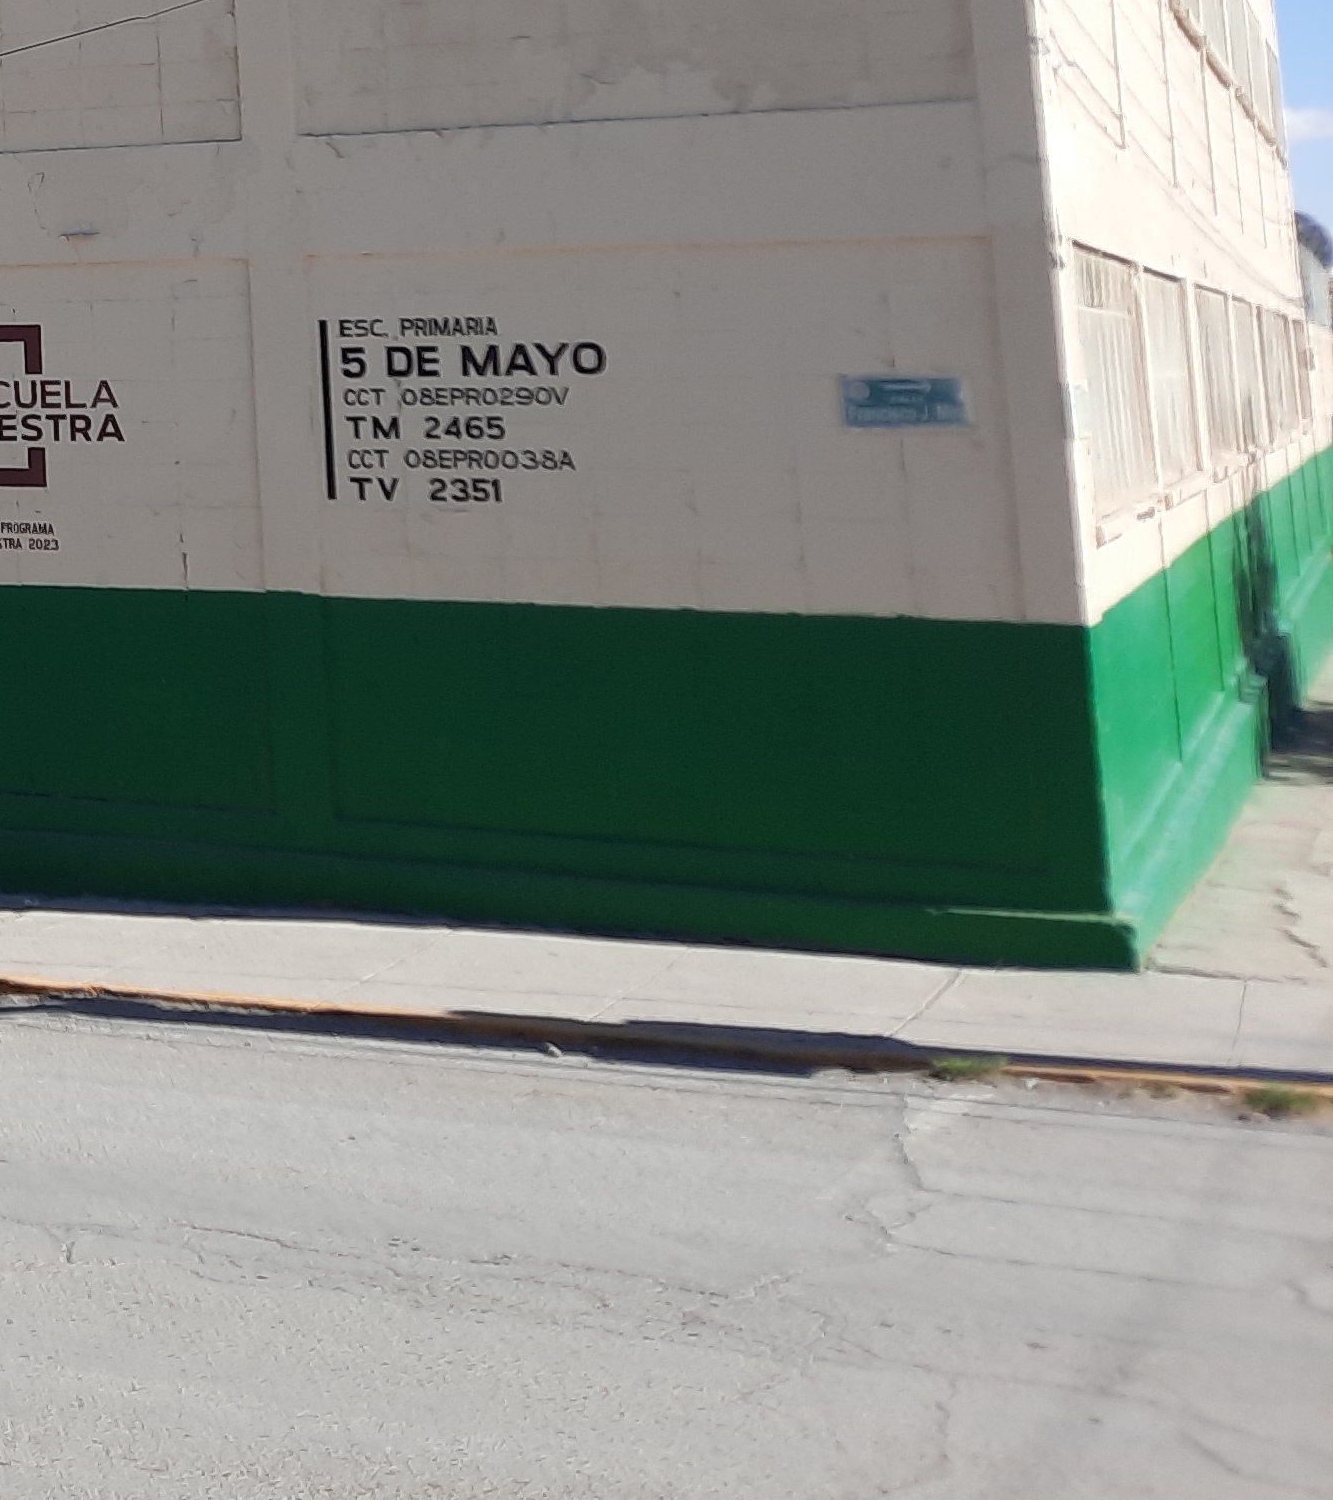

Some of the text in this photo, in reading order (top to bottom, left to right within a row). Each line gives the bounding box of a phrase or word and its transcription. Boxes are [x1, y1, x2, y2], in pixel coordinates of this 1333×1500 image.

[399, 316, 500, 337] PRIMARIA
[340, 342, 607, 378] 5 DE MAYO
[344, 388, 386, 406] CCT
[345, 415, 506, 439] TM 2465
[348, 449, 576, 471] CCT 08EPR0038A
[350, 477, 503, 502] TV 2351
[1, 522, 54, 536] PROGRAMA
[28, 538, 59, 551] 2023
